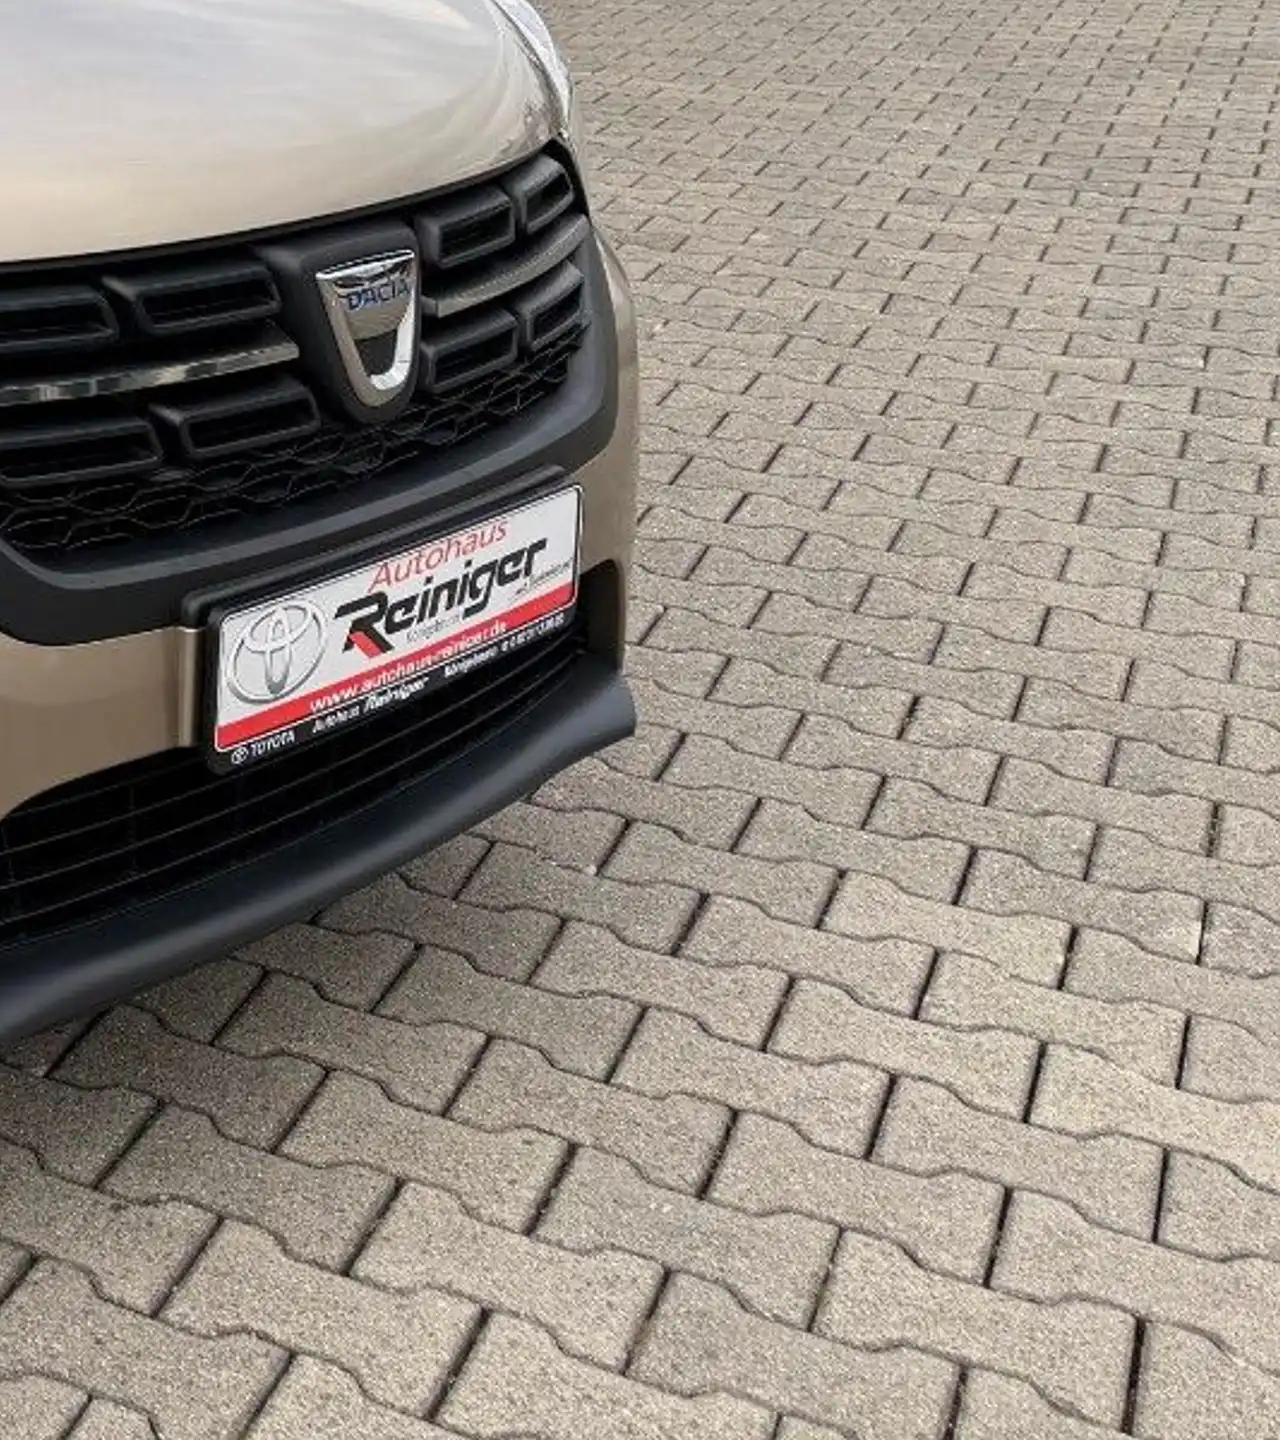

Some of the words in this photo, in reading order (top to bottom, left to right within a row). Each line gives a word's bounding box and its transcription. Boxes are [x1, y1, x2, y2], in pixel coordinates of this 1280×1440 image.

[347, 278, 410, 310] DACIA
[367, 521, 509, 594] Autohaus
[335, 538, 547, 658] Reiniger
[250, 732, 296, 758] TOYOTA
